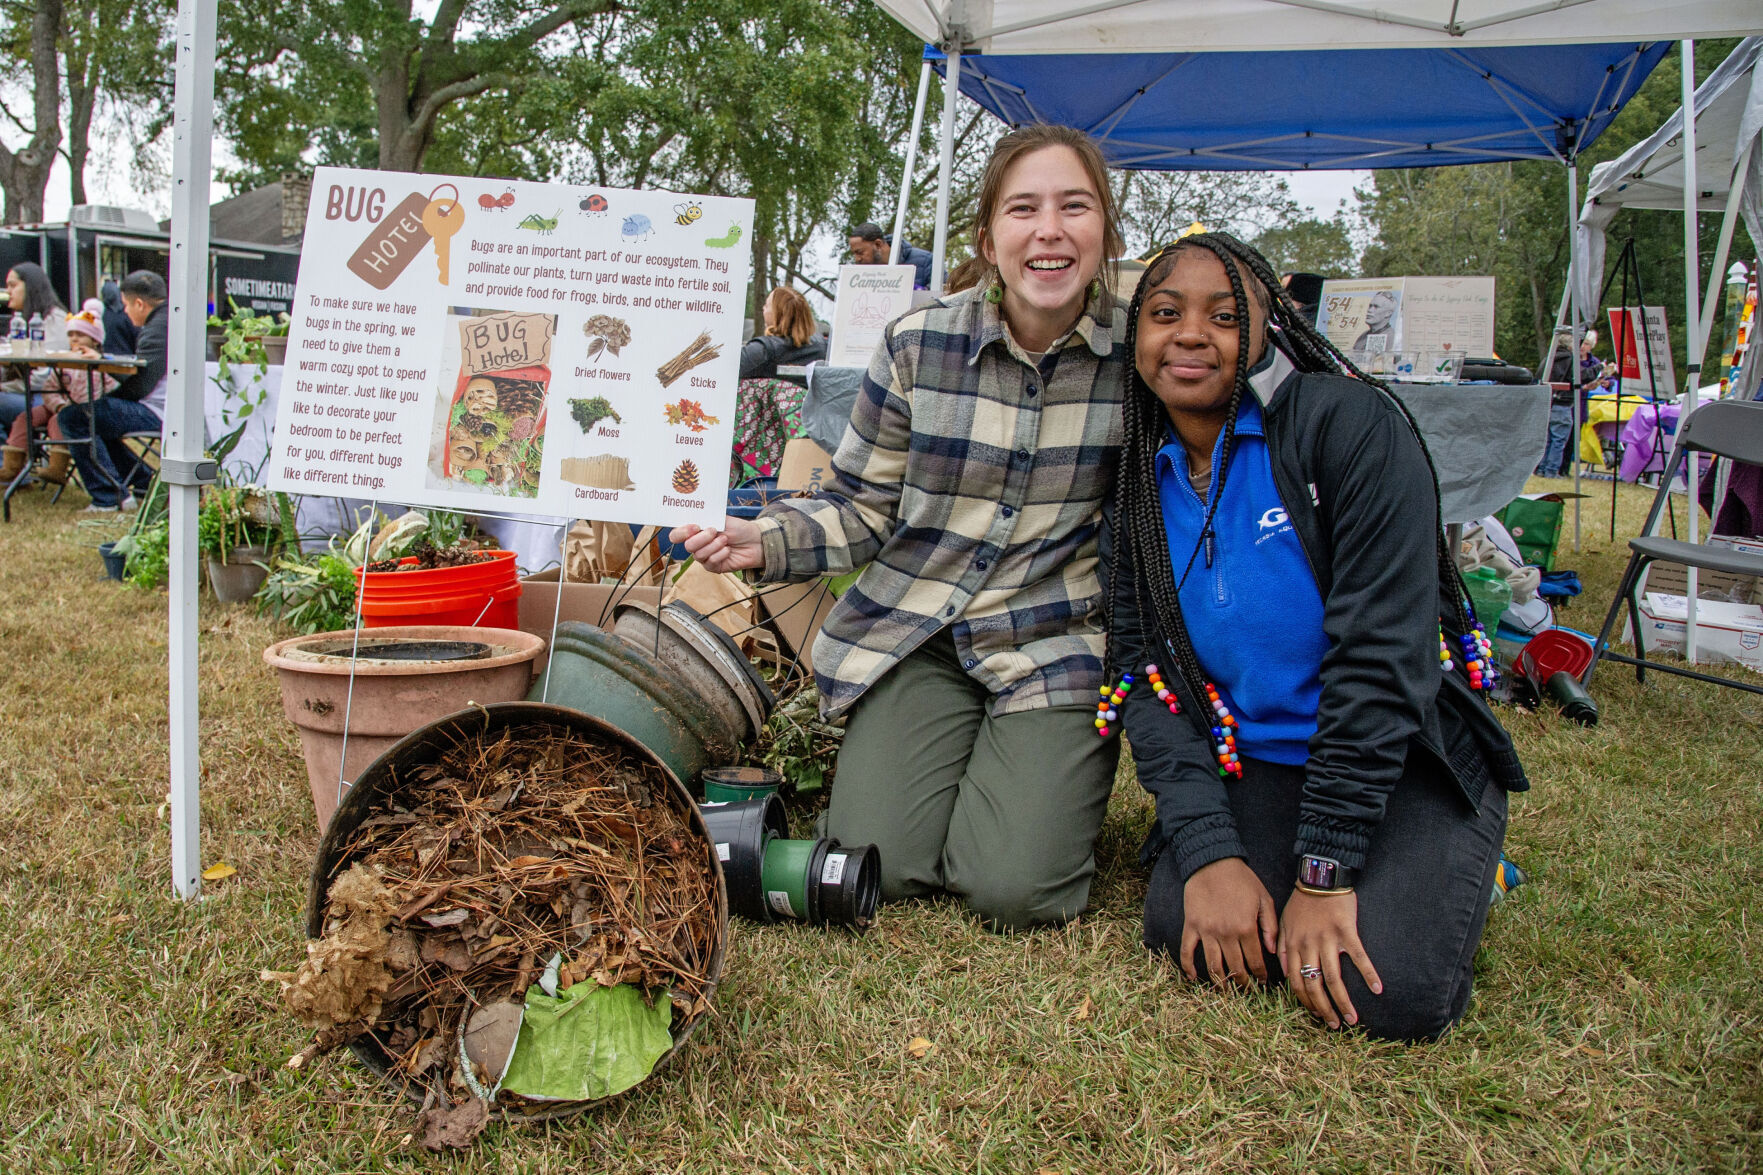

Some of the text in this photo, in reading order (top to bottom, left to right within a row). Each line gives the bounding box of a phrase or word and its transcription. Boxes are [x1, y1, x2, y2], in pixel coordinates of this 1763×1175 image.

[325, 184, 386, 224] BUG
[471, 240, 728, 274] Bugs are an important part of our ecosystem. They
[468, 262, 731, 294] pollinate our plants, turn yard waste into fertile soil,
[849, 274, 904, 292] Campout
[310, 295, 416, 315] To make sure we have
[466, 283, 724, 314] and provide food for frogs, birds, and other wildlife.
[306, 317, 416, 337] bugs in the spring, we
[1339, 317, 1358, 328] 54
[473, 320, 528, 349] BUG
[302, 338, 400, 356] need to give them a
[480, 341, 528, 369] Hotel
[300, 360, 426, 381] warm cozy spot to spend
[574, 366, 631, 382] Dried flowers
[296, 380, 419, 404] the winter. Just like you
[690, 377, 716, 388] Sticks
[293, 402, 397, 423] like to decorate your
[290, 424, 402, 444] bedroom to be perfect
[598, 426, 620, 438] Moss
[676, 434, 704, 446] Leaves
[287, 445, 402, 468] for you, different bugs
[284, 467, 386, 490] like different things.
[574, 488, 619, 502] Cardboard
[662, 495, 705, 509] Pinecones
